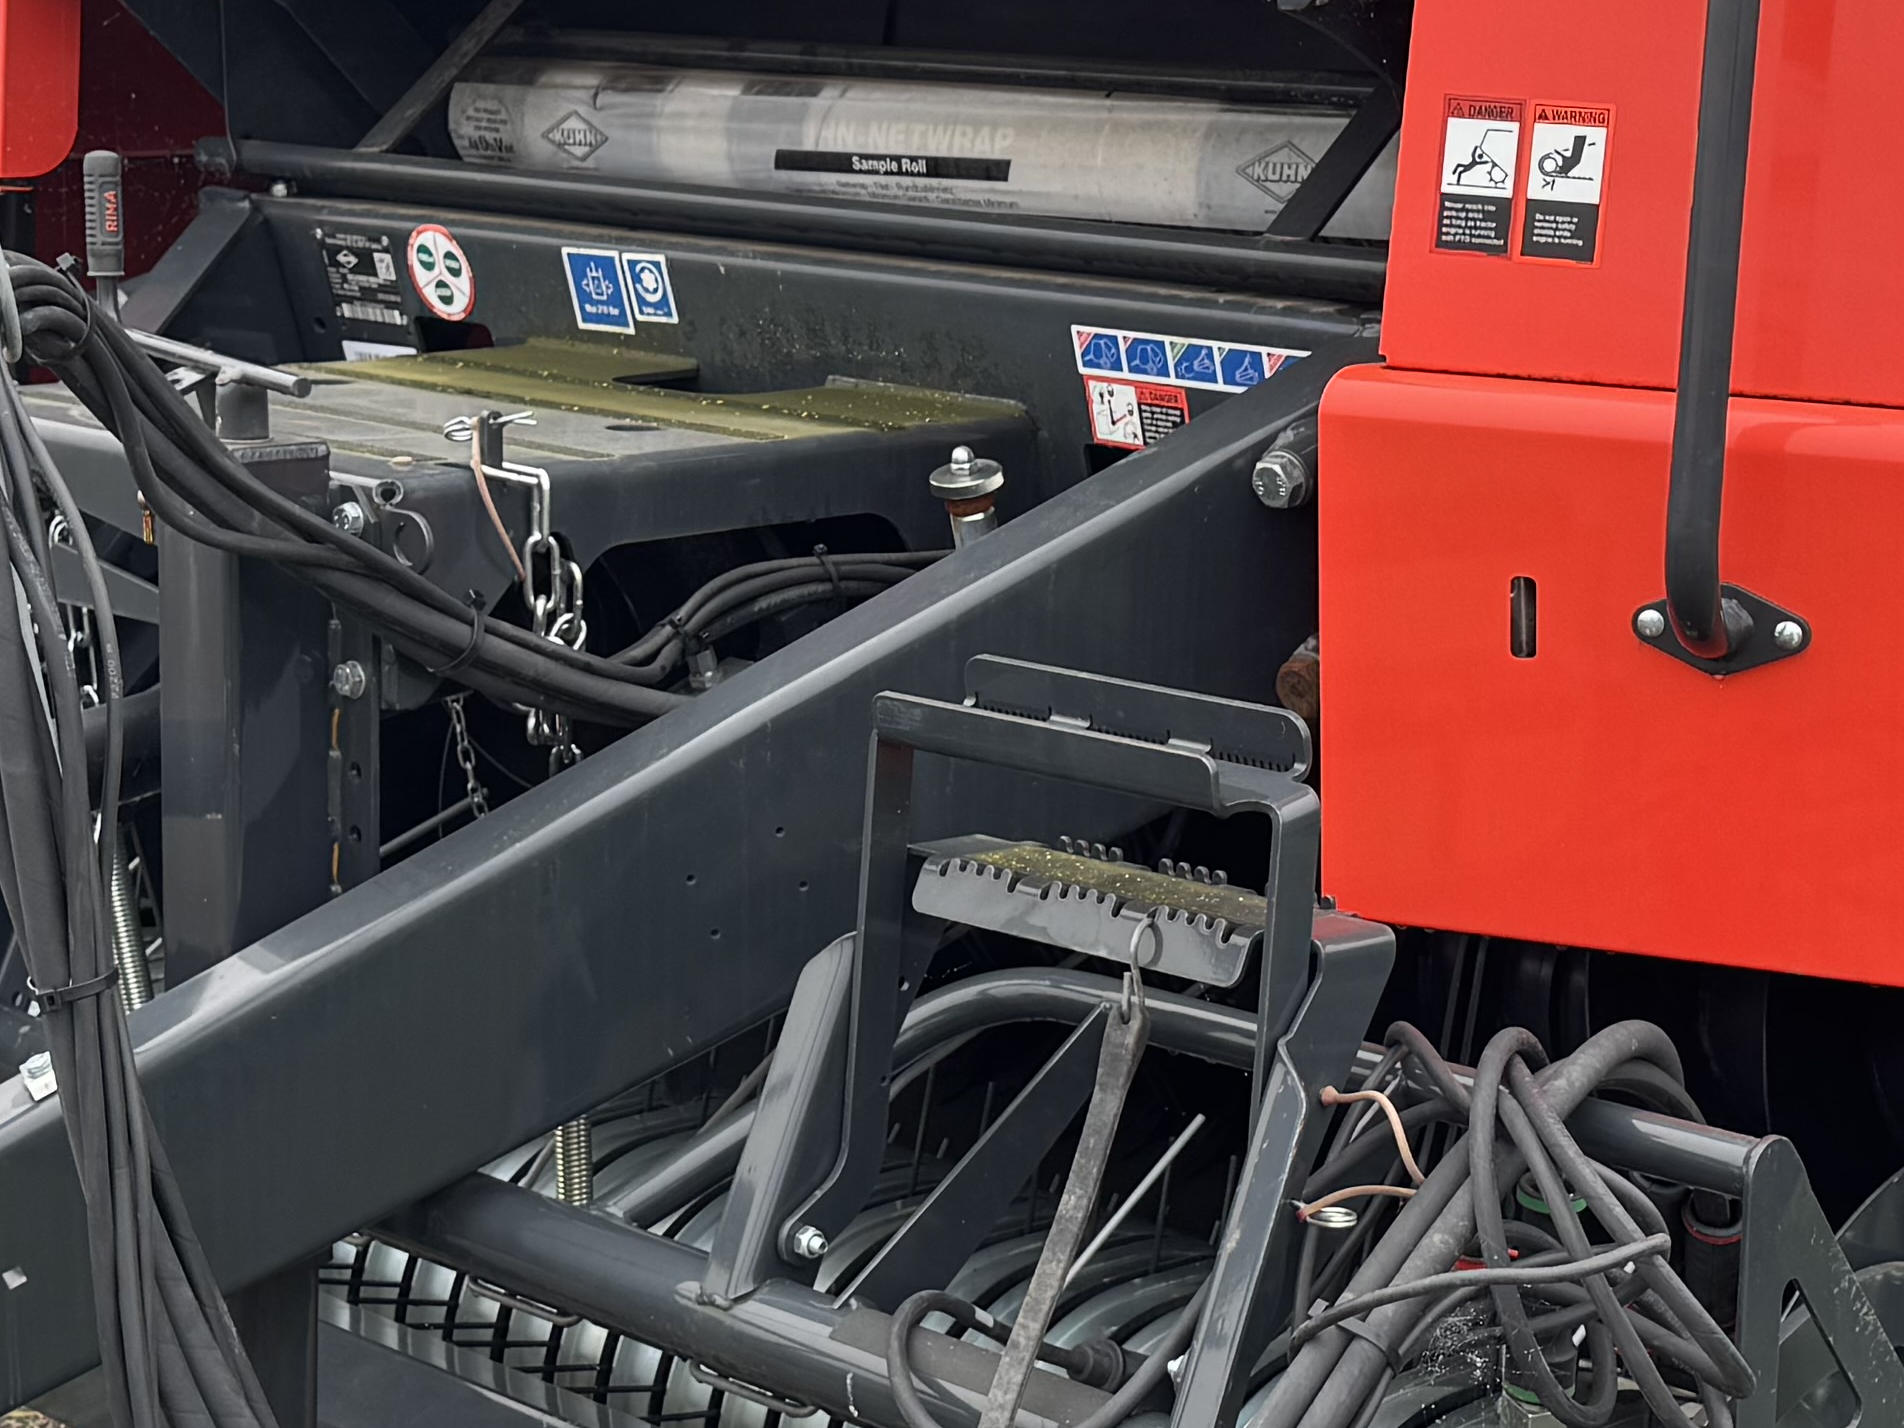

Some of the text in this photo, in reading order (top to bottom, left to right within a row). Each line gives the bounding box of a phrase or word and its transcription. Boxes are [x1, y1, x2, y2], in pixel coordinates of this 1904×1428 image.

[1468, 103, 1515, 119] DANGER
[1551, 109, 1606, 125] WARNING
[553, 127, 597, 147] KUHN
[852, 155, 927, 174] Sample Roll
[103, 190, 118, 233] RIMA
[1148, 390, 1180, 404] DANGER
